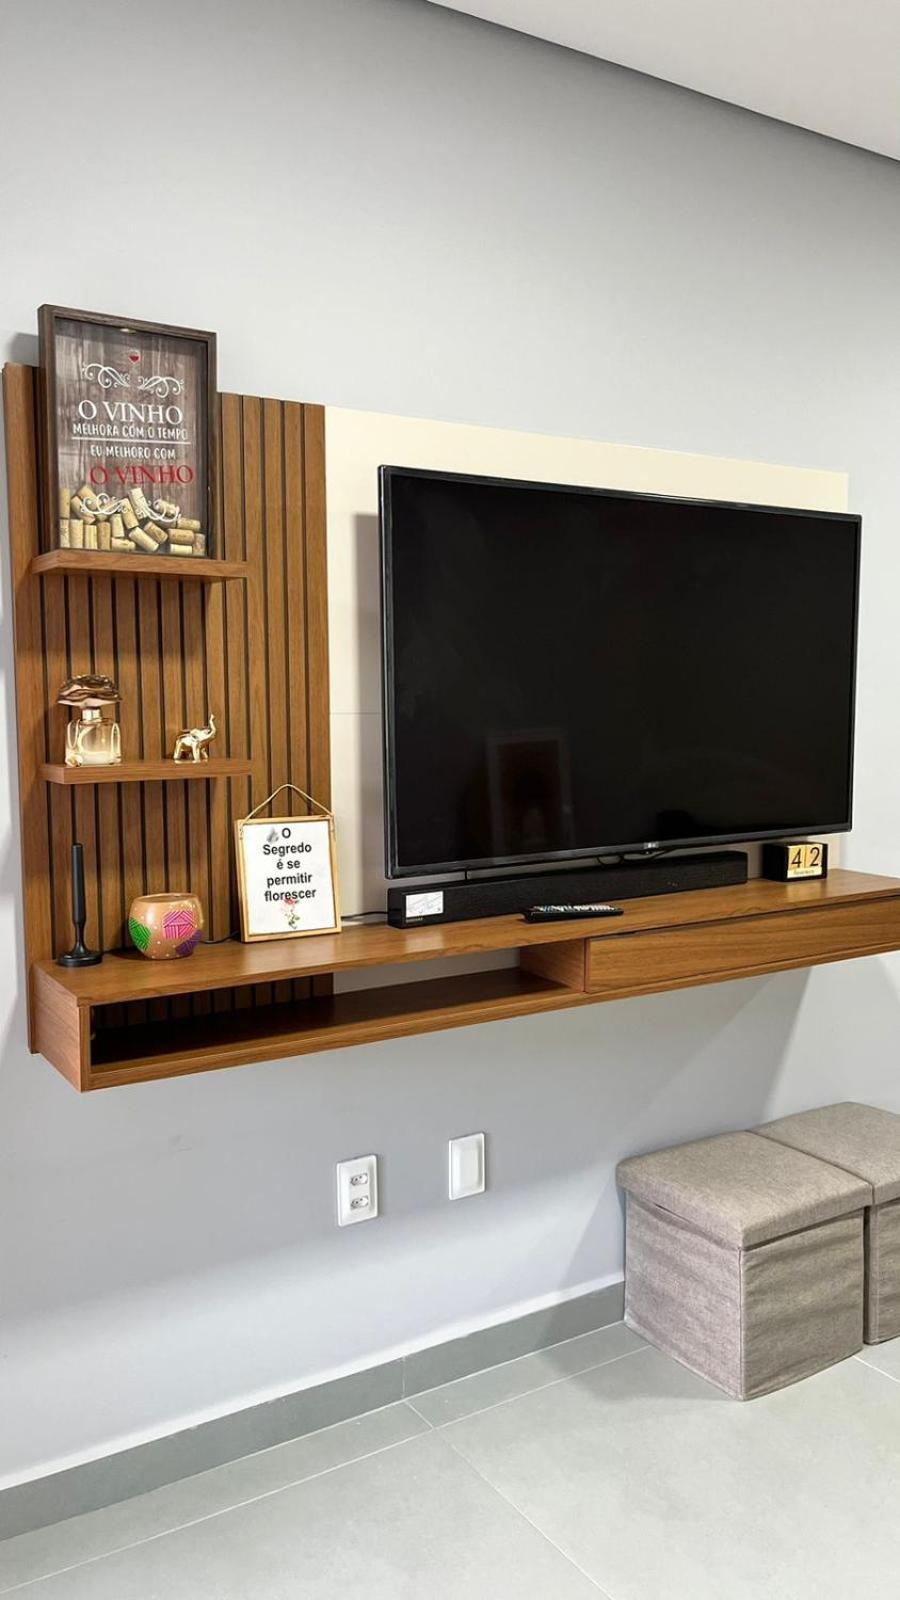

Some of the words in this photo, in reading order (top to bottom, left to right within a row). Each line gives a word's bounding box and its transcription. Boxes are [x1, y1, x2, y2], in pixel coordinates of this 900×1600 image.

[78, 399, 98, 420] O
[102, 401, 184, 425] VINHO
[73, 422, 119, 437] MELHORA
[148, 426, 155, 439] O
[158, 427, 188, 441] TEMPO
[90, 444, 102, 457] EU
[106, 446, 151, 459] MELHORO
[154, 447, 176, 460] COM
[90, 465, 109, 485] O
[115, 464, 194, 485] VINHO
[281, 827, 291, 839] O
[262, 842, 312, 857] Segredo
[276, 858, 284, 870] é
[287, 860, 301, 869] se
[266, 872, 313, 888] permitir
[264, 889, 317, 902] florescer
